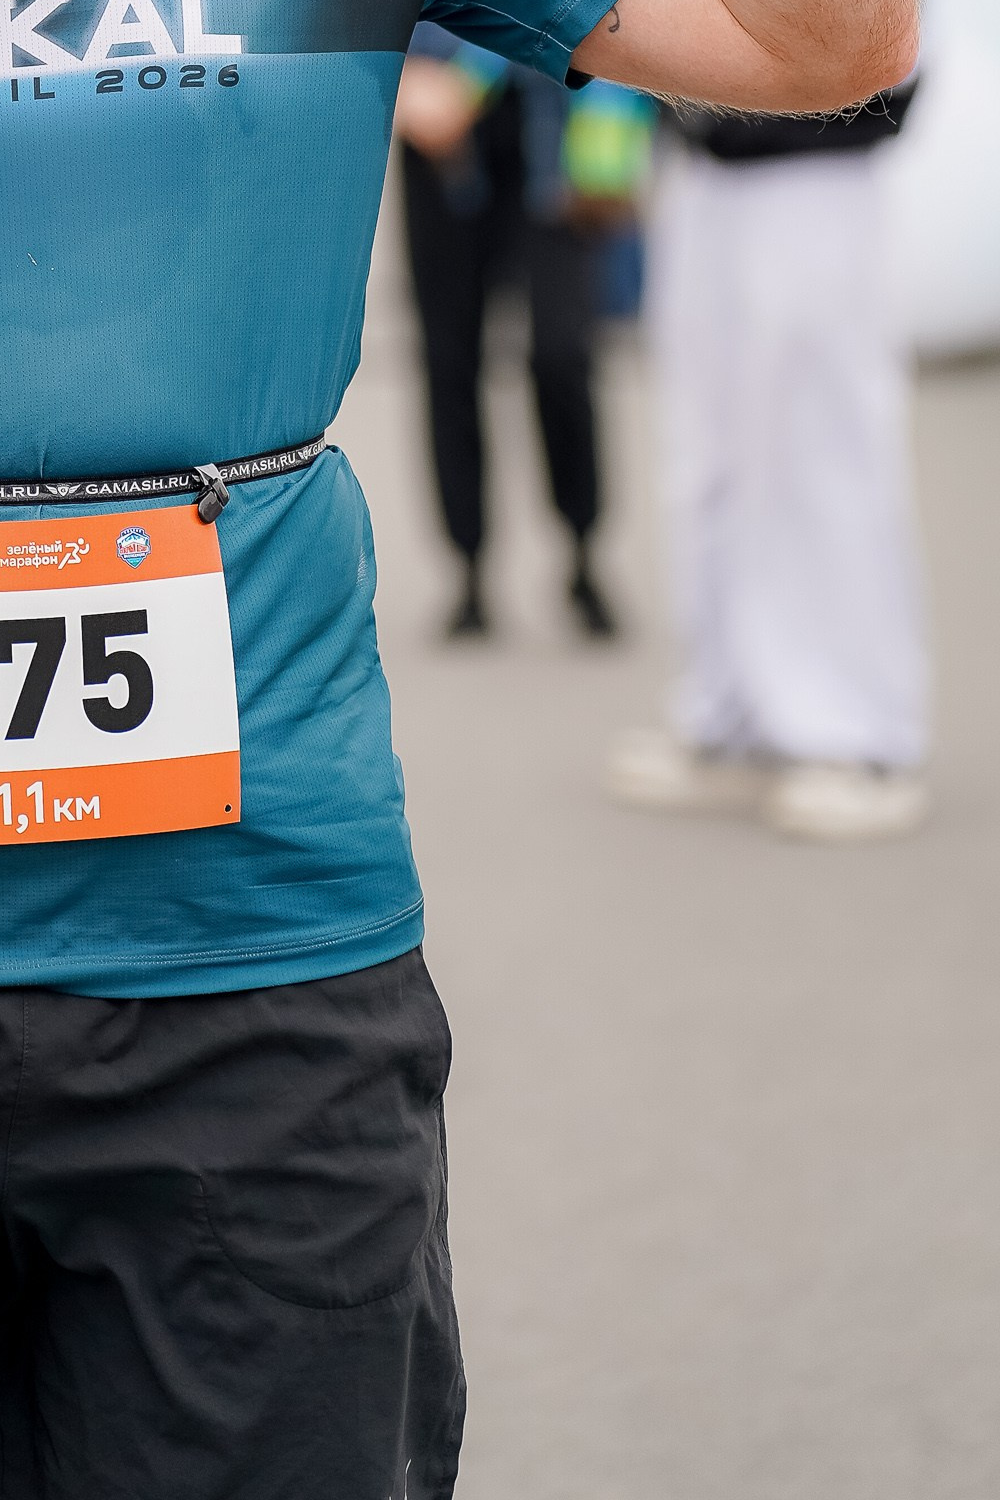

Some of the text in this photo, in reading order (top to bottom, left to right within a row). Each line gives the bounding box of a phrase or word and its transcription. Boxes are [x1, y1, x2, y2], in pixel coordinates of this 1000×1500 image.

[95, 63, 240, 95] 2026
[85, 474, 190, 495] GAMASH.RU
[219, 452, 296, 480] GAMASH.RU
[6, 539, 63, 556] зелёный
[0, 555, 58, 570] марафон
